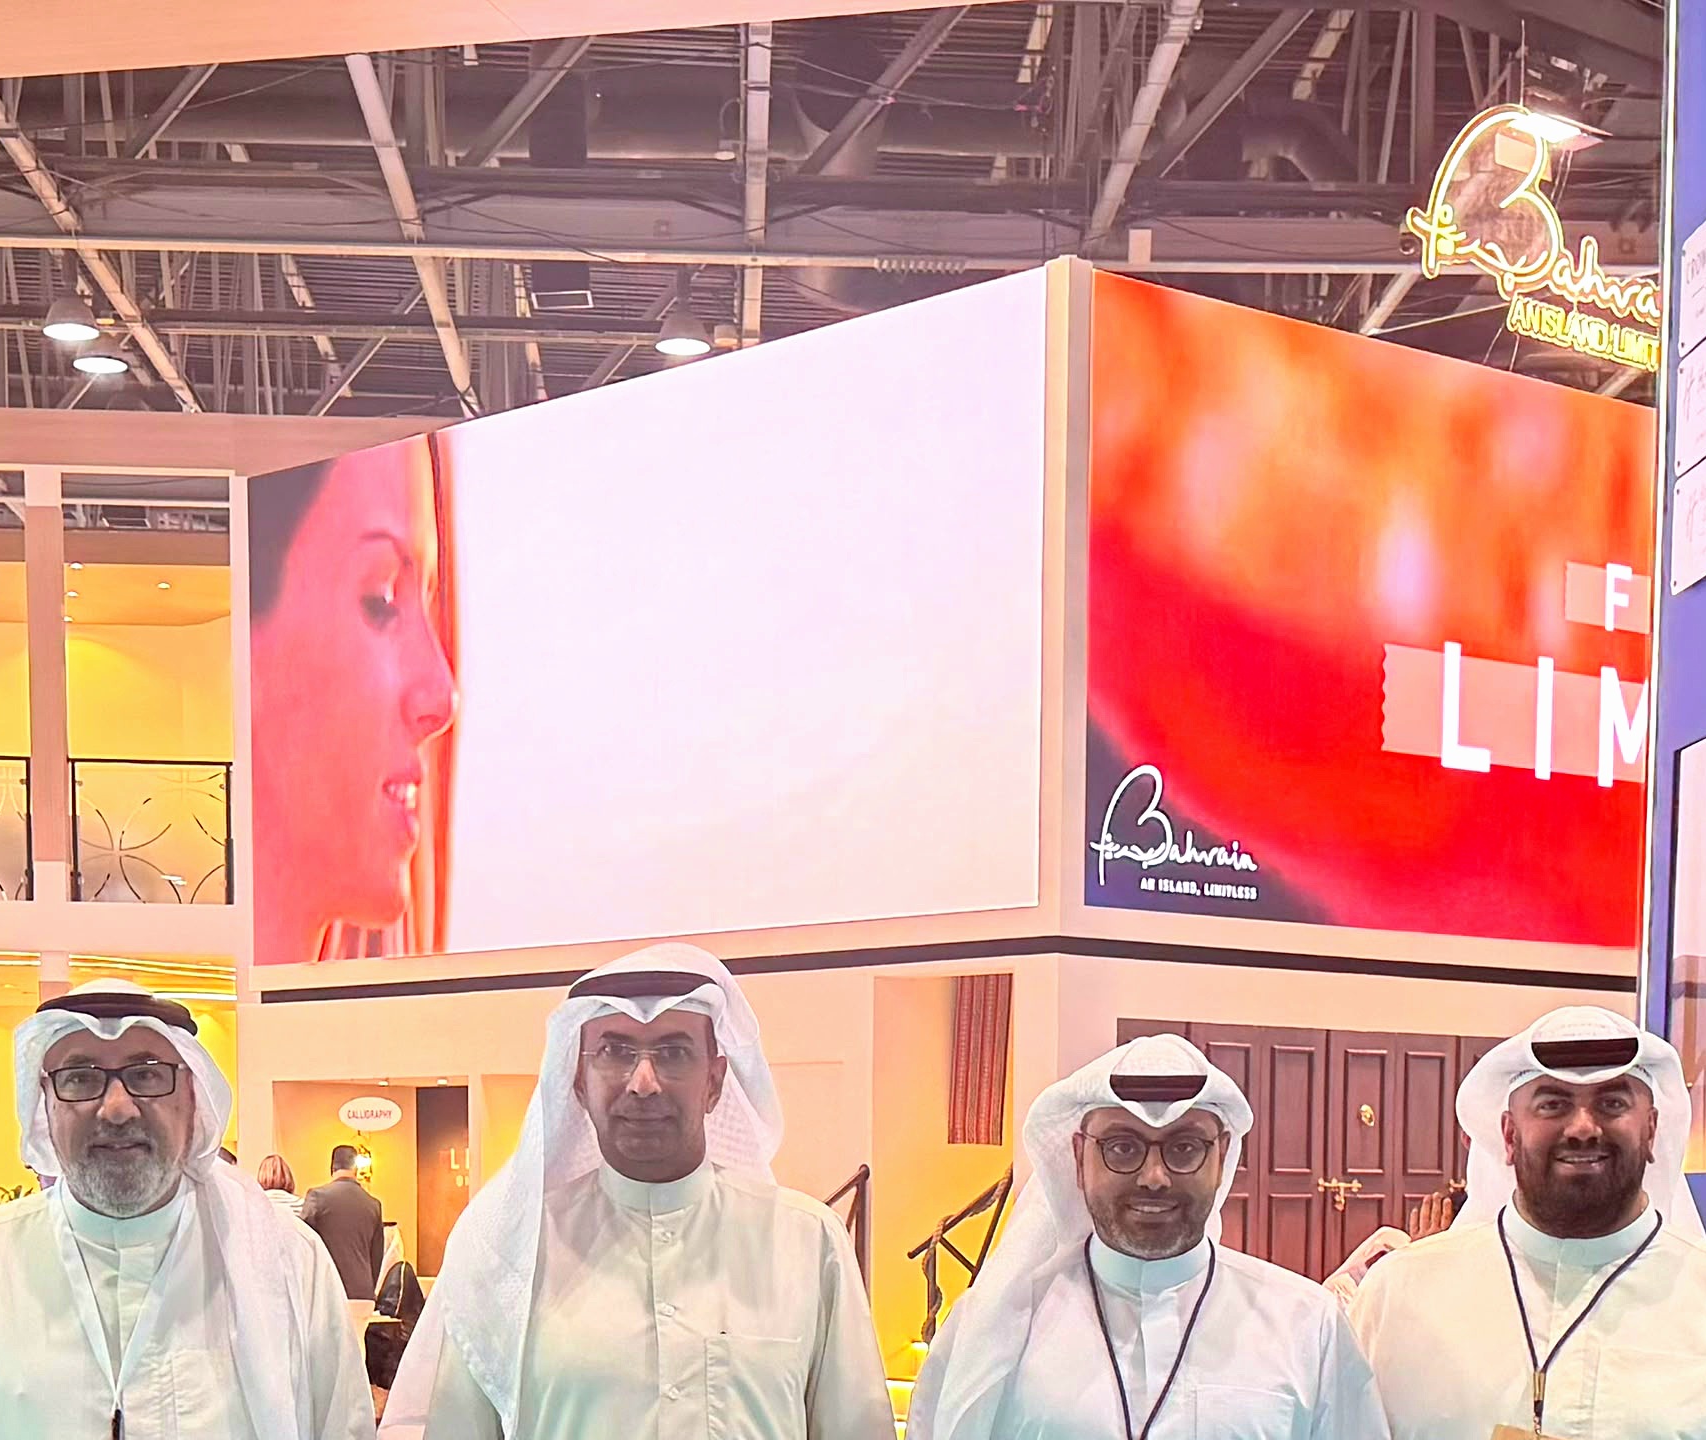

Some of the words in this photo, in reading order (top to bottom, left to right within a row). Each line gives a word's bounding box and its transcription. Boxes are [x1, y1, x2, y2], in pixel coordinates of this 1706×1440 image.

[1612, 325, 1660, 367] LIMIT
[1604, 563, 1633, 631] F
[1441, 641, 1649, 788] LIM
[1098, 764, 1258, 887] Bahrain
[1140, 877, 1156, 891] AN
[1203, 883, 1258, 900] LIMITLESS
[346, 1109, 393, 1120] CALLIGRAPHY
